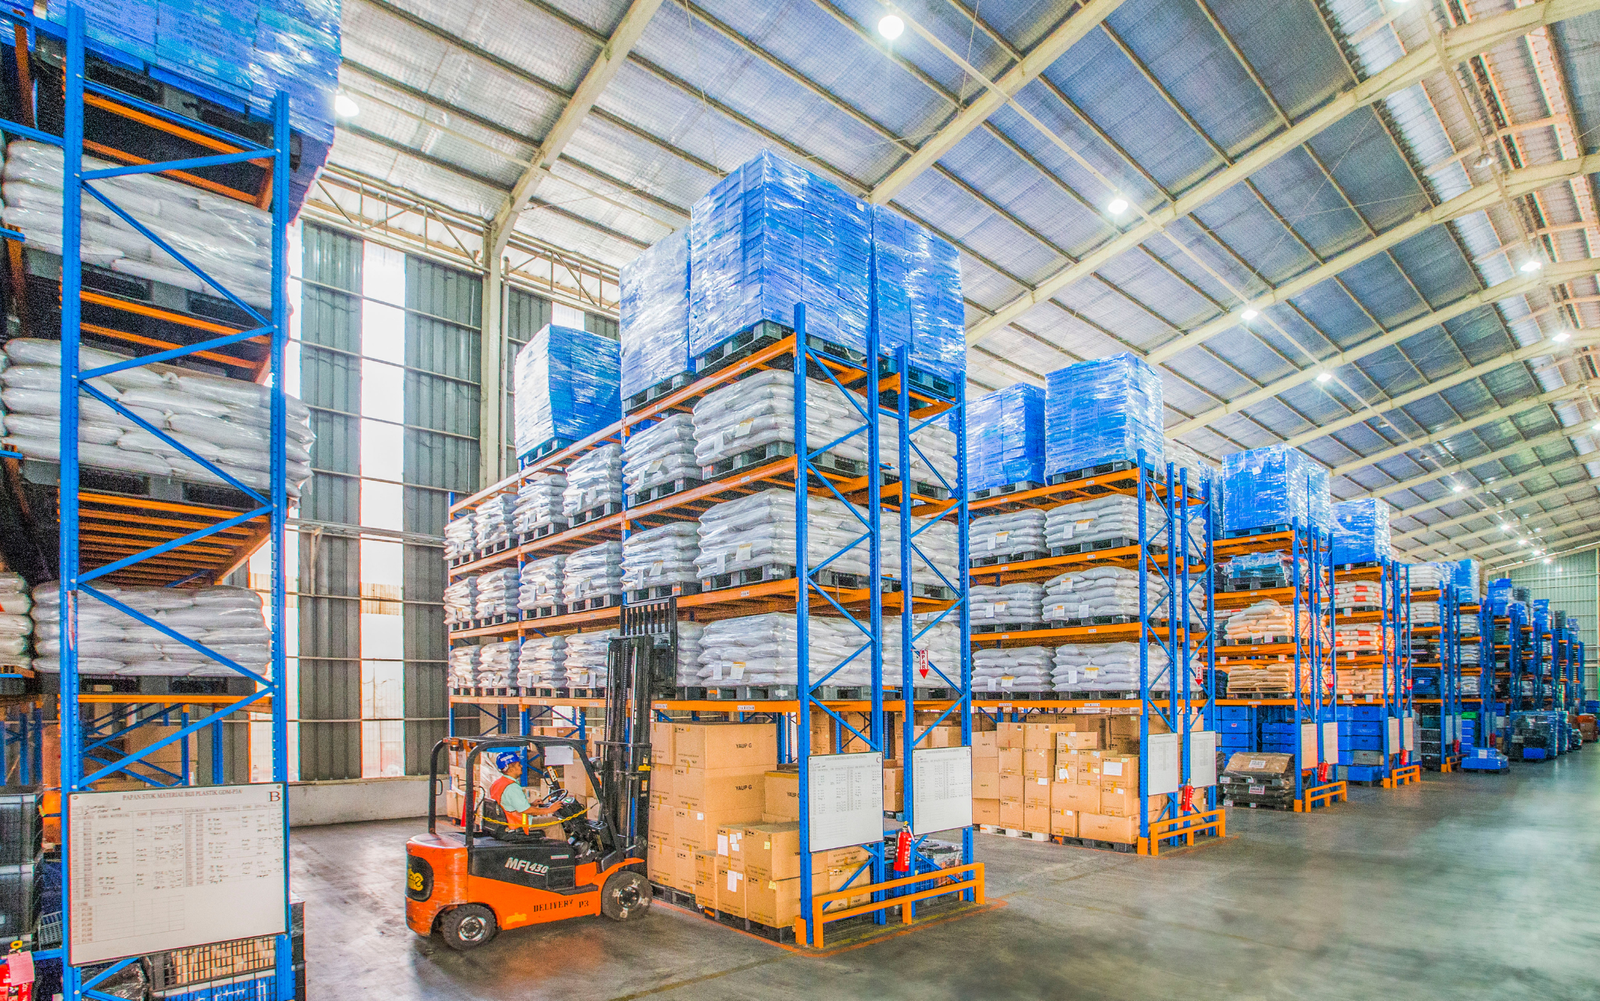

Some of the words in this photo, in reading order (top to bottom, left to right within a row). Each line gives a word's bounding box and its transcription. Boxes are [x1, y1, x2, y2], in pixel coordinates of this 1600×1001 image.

[157, 791, 184, 799] MATERIAL
[195, 789, 218, 797] PLASTIK
[268, 791, 281, 803] B
[533, 899, 574, 912] DELIVERY
[578, 900, 589, 908] P3
